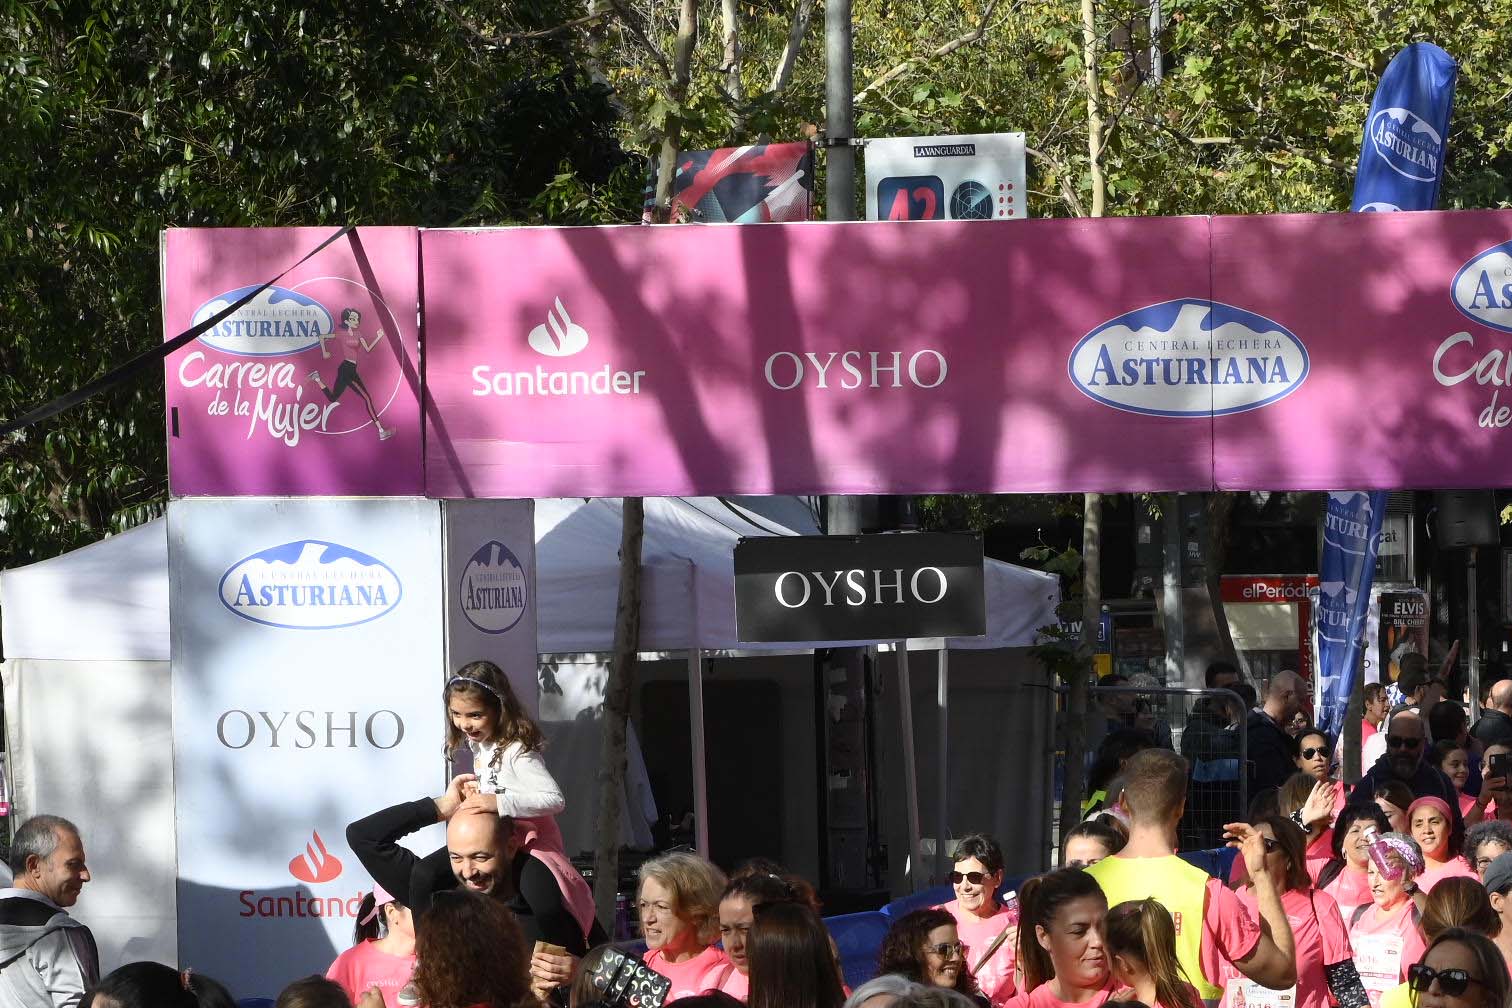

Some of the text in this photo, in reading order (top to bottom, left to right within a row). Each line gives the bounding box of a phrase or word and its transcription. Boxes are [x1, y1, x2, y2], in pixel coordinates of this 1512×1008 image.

[1375, 119, 1437, 175] ASTURIAN
[203, 311, 321, 338] ASTURIANA
[273, 308, 318, 318] LECHERA
[1124, 338, 1283, 353] CENTRAL LECHERA
[178, 350, 296, 390] Carrera
[472, 362, 646, 398] Santander
[764, 349, 948, 390] OYSHO
[1087, 343, 1291, 387] ASTURIANA
[207, 389, 249, 417] de la
[247, 385, 341, 447] Mujer
[1477, 390, 1512, 429] de
[232, 573, 389, 608] ASTURIANA
[465, 575, 524, 611] ASTURIANA
[774, 566, 948, 609] OYSHO
[1394, 602, 1424, 615] ELVIS
[216, 709, 405, 750] OYSHO
[239, 891, 363, 919] Santand
